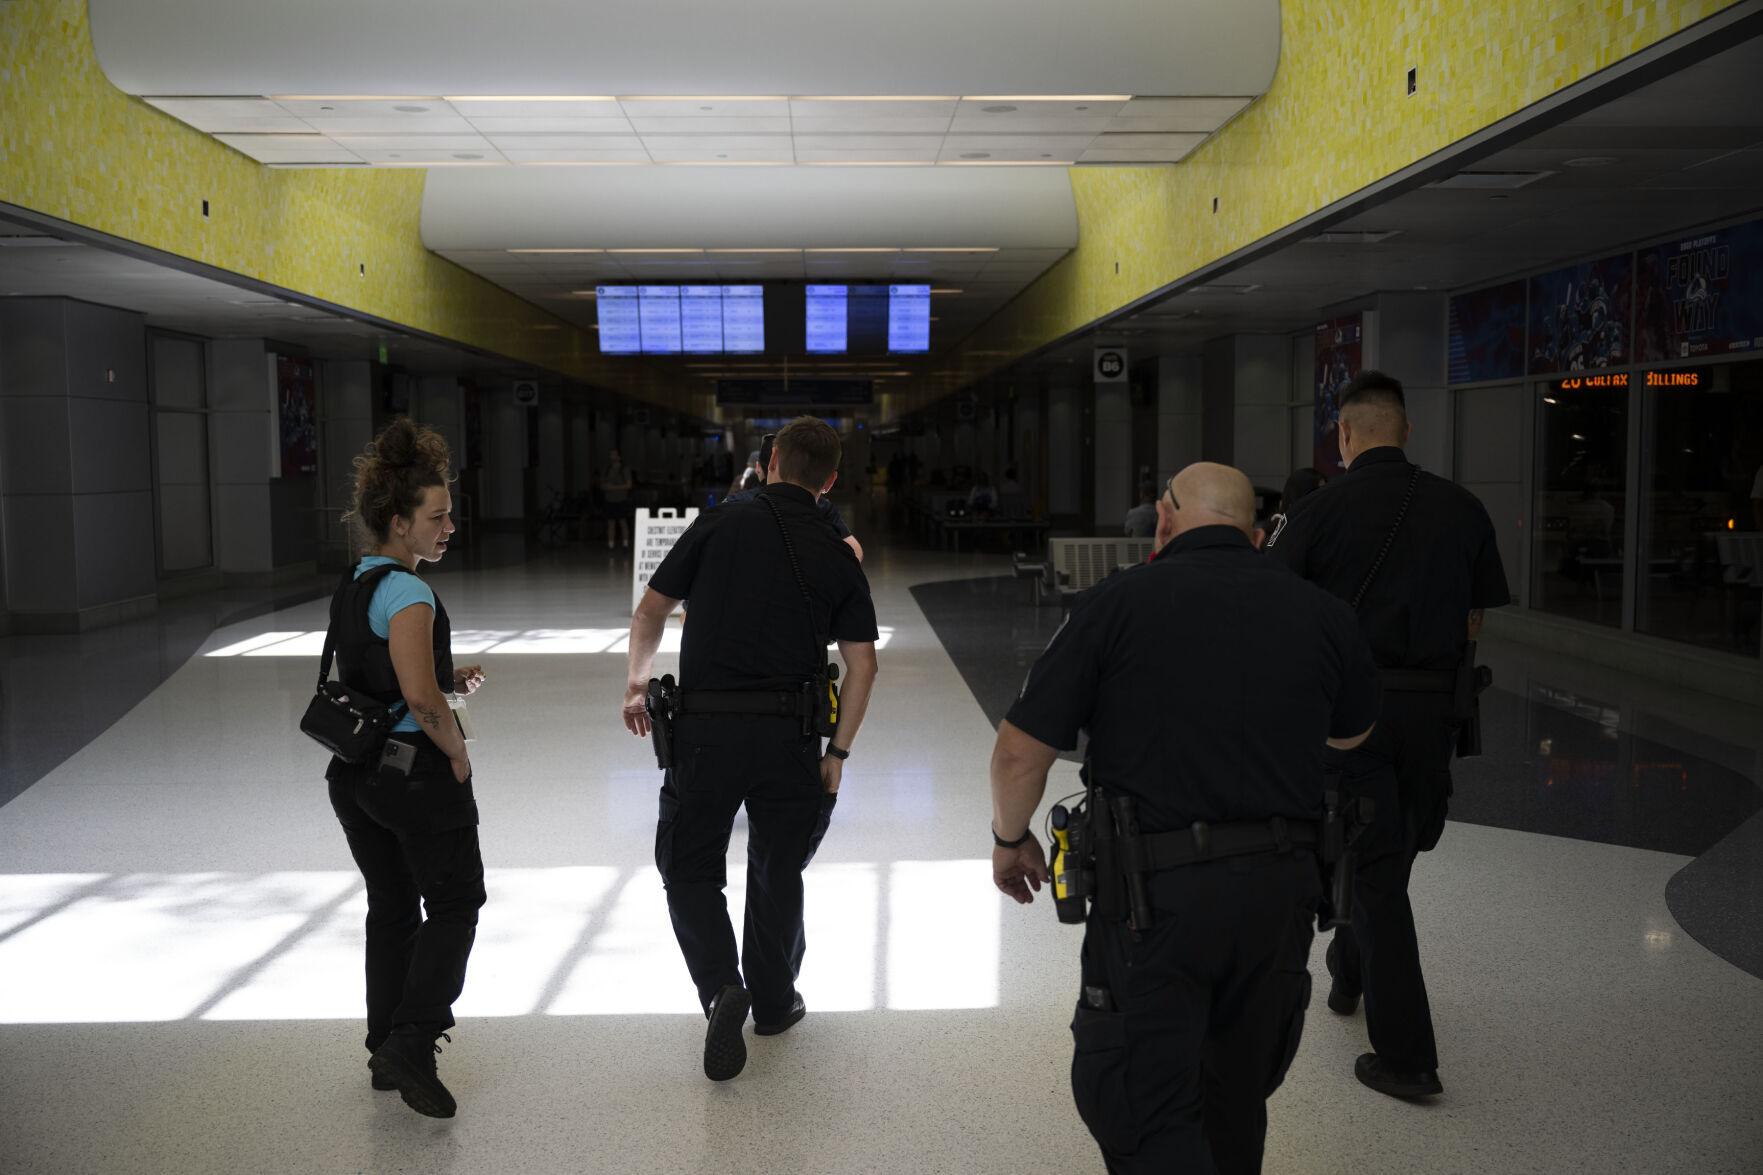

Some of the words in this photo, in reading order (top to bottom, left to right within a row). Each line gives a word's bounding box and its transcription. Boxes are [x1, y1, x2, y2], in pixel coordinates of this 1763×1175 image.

[1666, 245, 1729, 290] FOUND
[1672, 291, 1720, 334] WAY
[1646, 371, 1699, 387] BILLINGS
